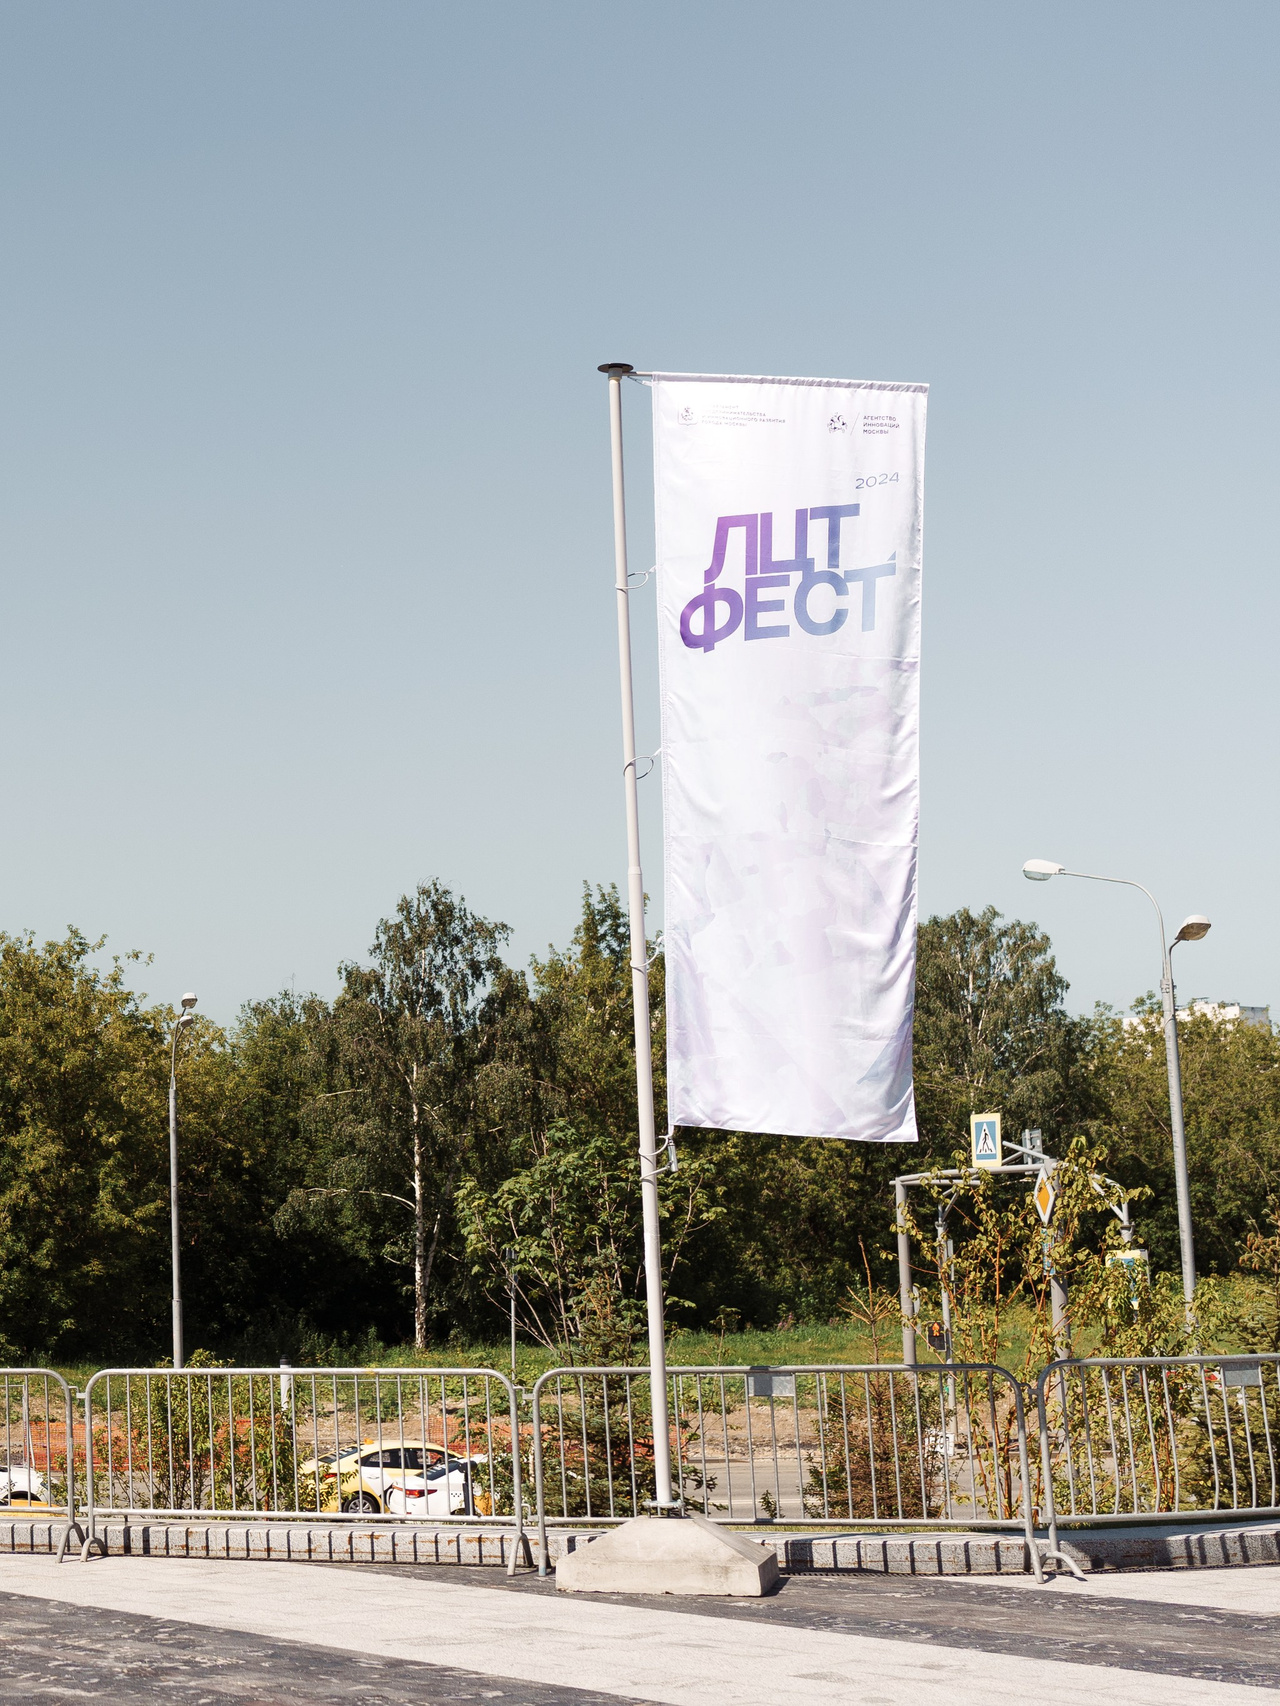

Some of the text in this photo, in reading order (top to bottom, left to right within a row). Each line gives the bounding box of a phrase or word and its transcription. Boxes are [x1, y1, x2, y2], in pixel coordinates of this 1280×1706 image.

[863, 421, 900, 429] ИННОВАЦИЙ
[855, 471, 900, 490] 2024
[704, 503, 860, 585] ЛЦТ
[679, 550, 897, 654] ФЕСТ
